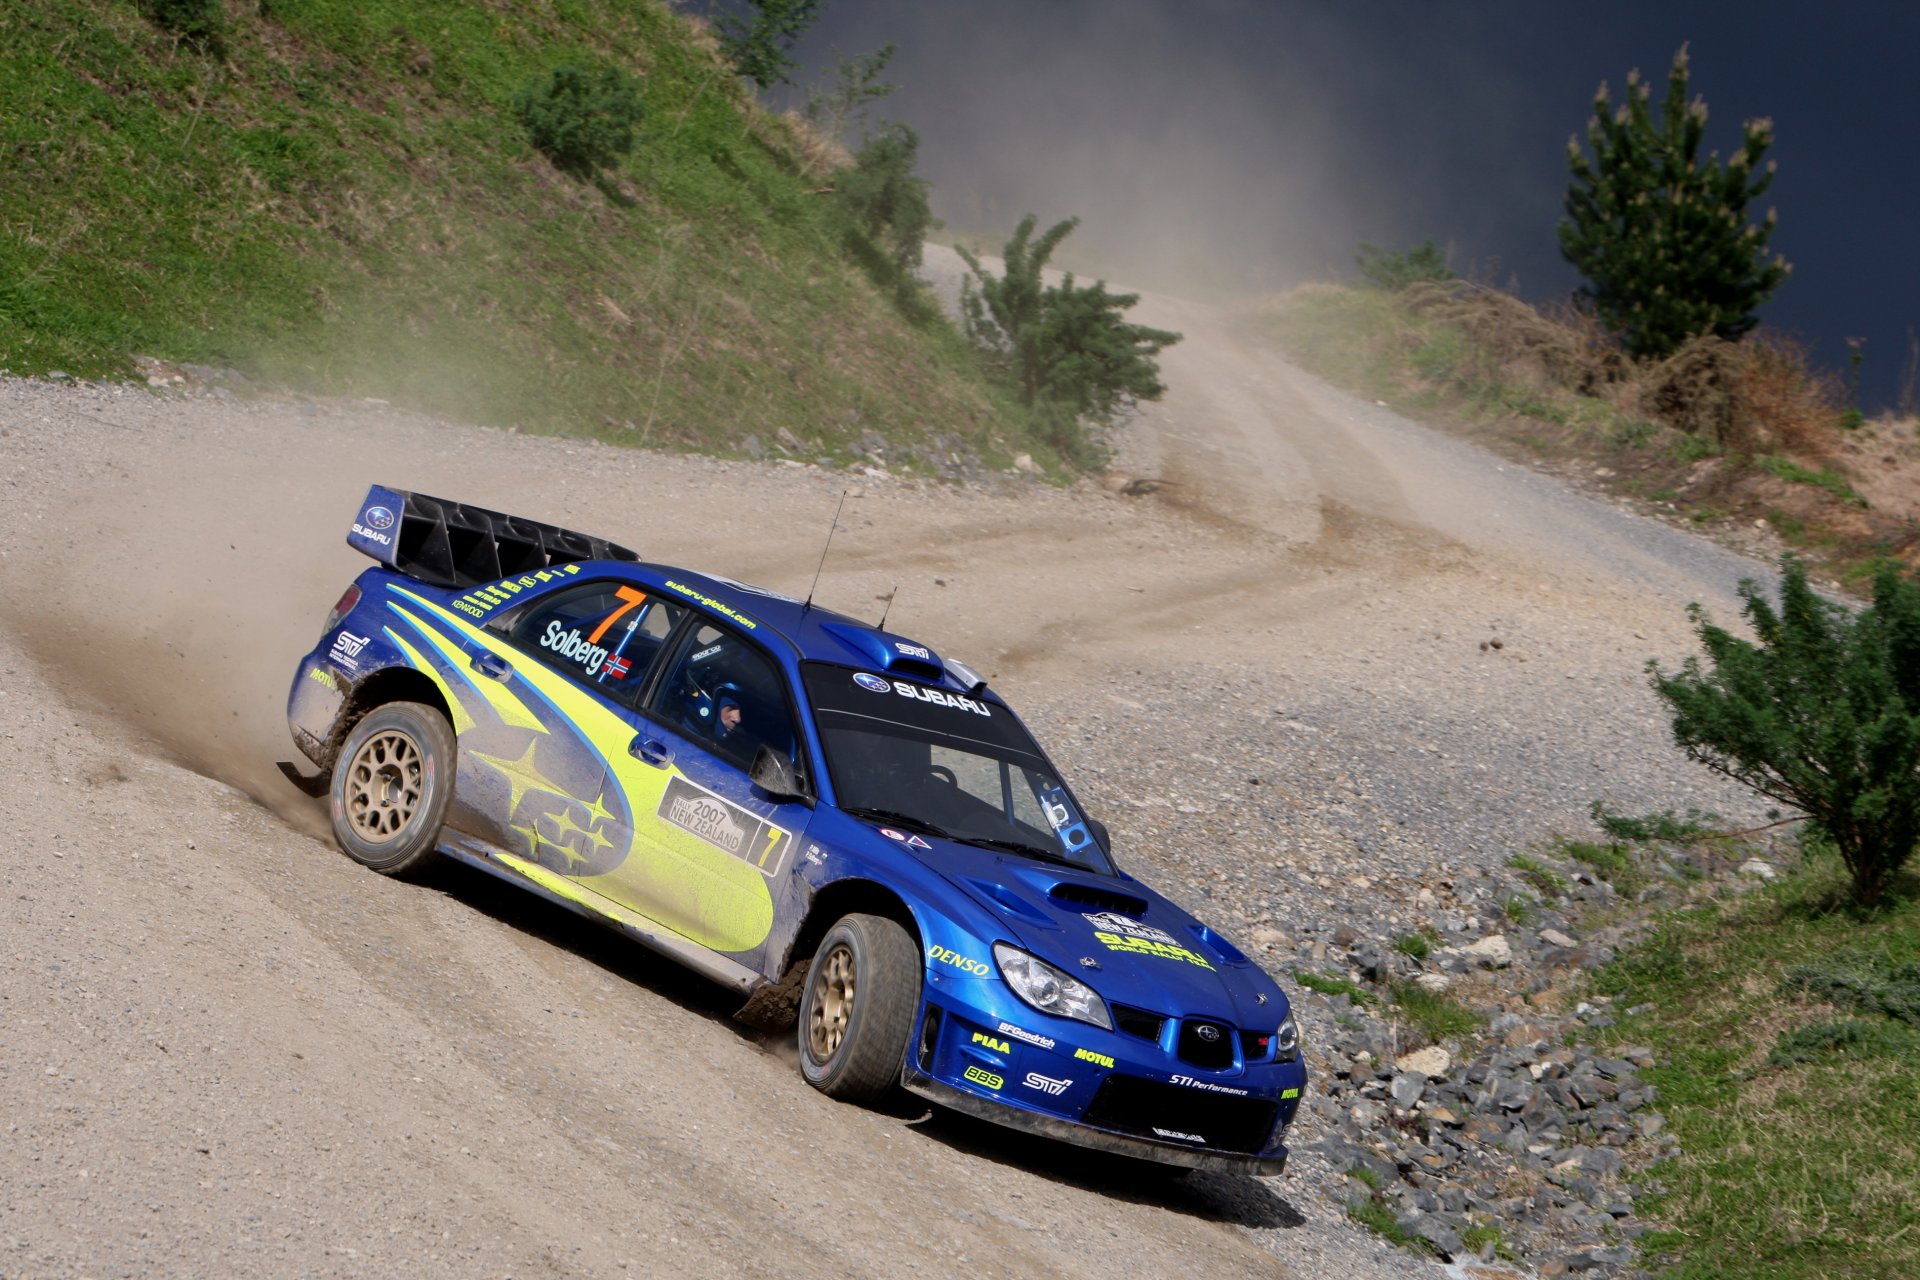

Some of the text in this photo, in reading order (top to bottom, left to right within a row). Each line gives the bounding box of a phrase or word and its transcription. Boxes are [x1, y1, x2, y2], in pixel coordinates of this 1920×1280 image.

[352, 523, 391, 545] SUBARU
[452, 600, 484, 618] KENWOOD
[587, 585, 648, 645] 7
[665, 580, 757, 629] subaru-global.com
[540, 620, 609, 675] Solberg
[894, 681, 991, 717] SUBARU
[693, 800, 727, 826] 2007
[670, 806, 740, 850] NEW ZEALAND
[757, 827, 783, 868] 7
[928, 944, 990, 977] DENSO
[1094, 931, 1209, 965] SUBARU
[1106, 944, 1149, 954] WORLD
[1150, 950, 1184, 962] RALLY
[971, 1032, 1011, 1055] PIAA
[998, 1022, 1056, 1048] BFGoodrich
[1074, 1048, 1115, 1069] MOTUL
[965, 1067, 1002, 1088] BBS
[1169, 1074, 1248, 1096] STI Performance
[1281, 1088, 1299, 1099] MOTUL
